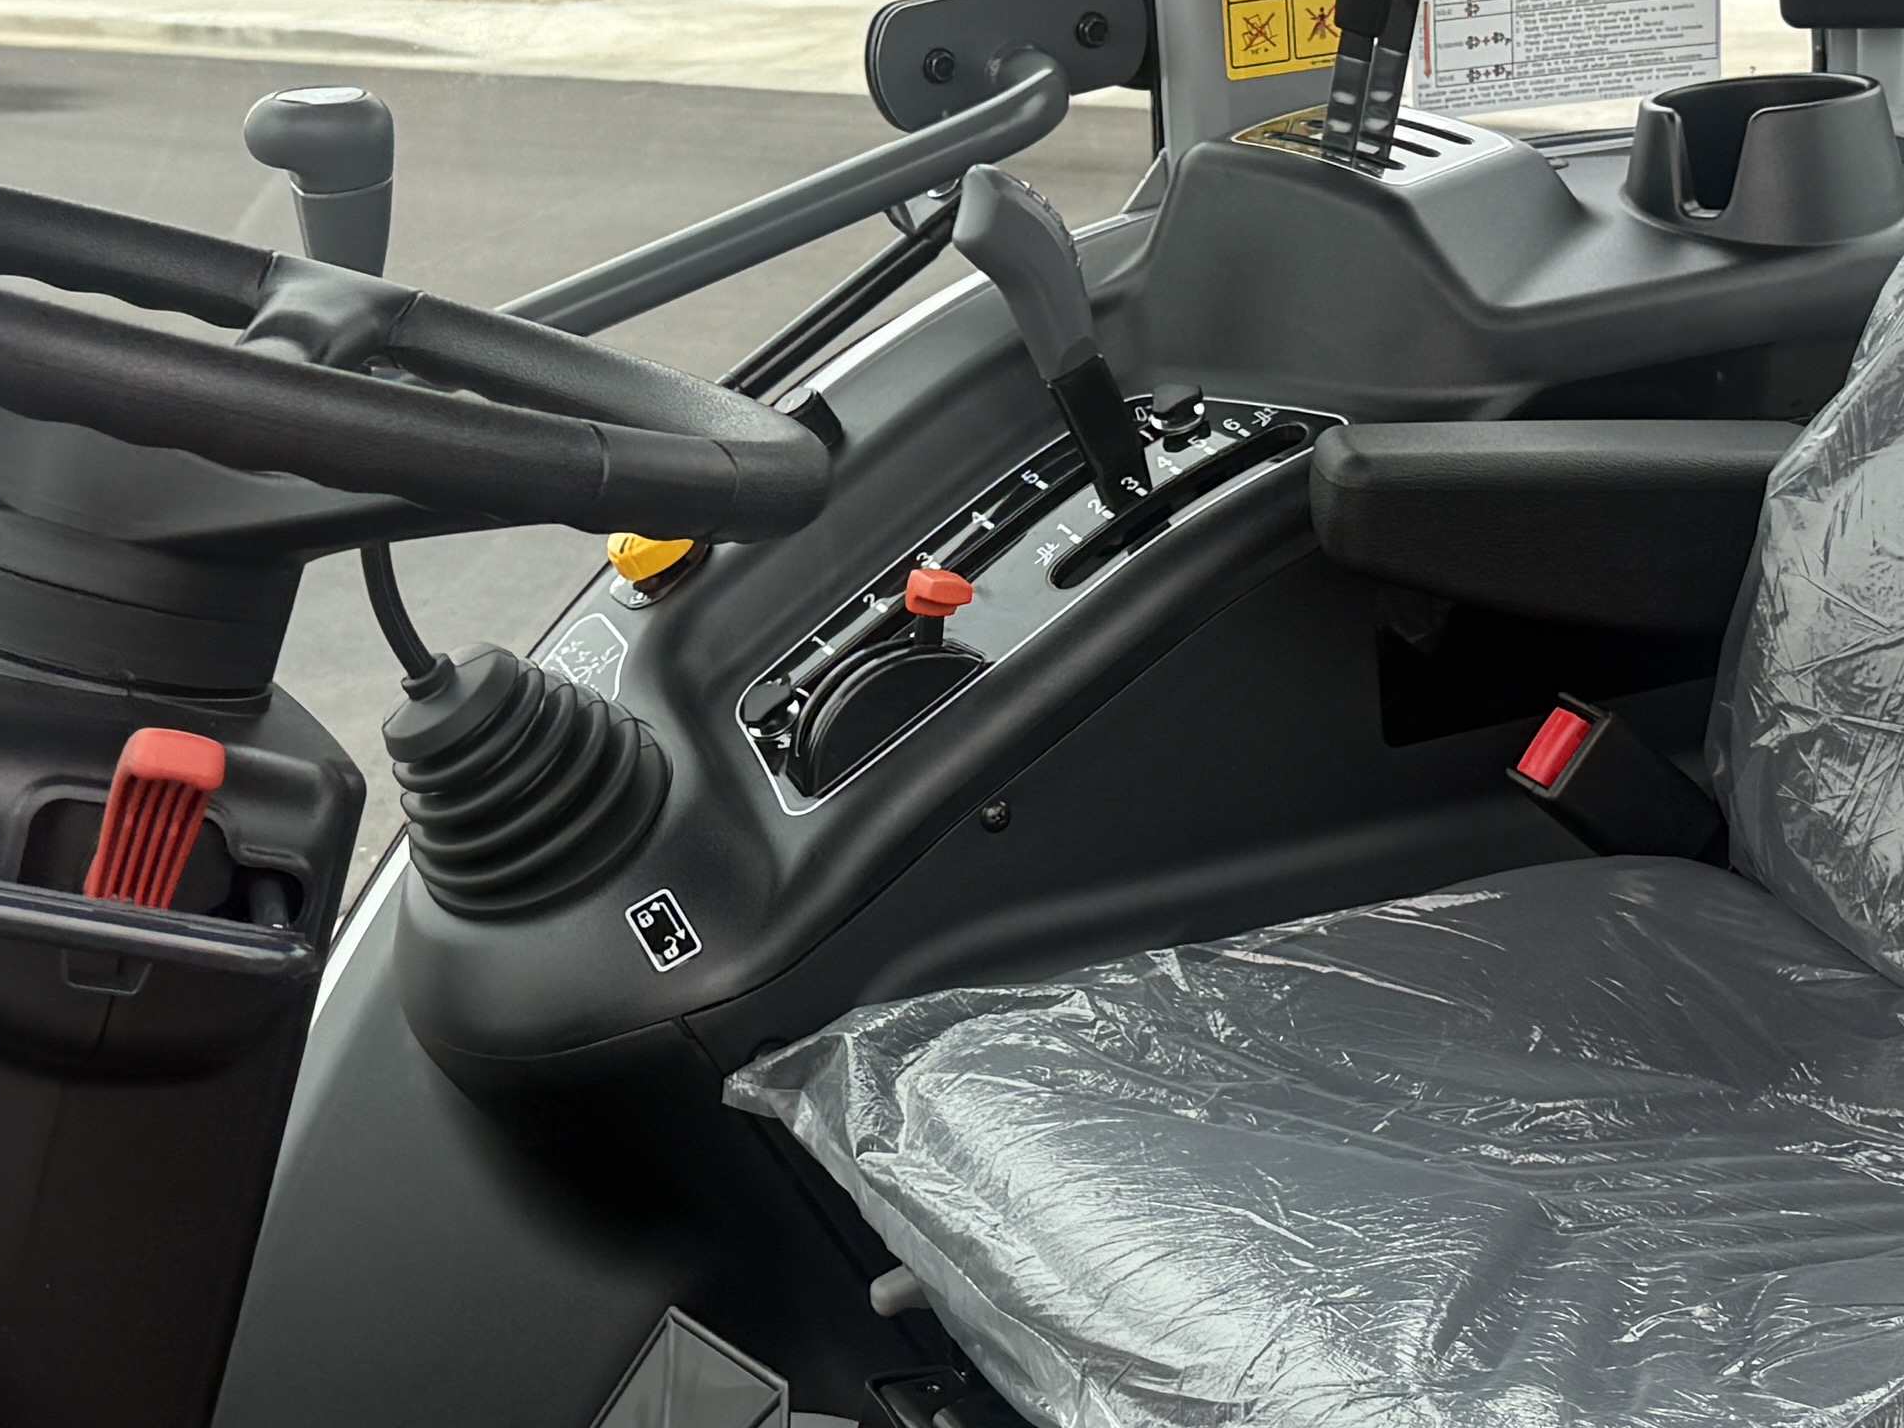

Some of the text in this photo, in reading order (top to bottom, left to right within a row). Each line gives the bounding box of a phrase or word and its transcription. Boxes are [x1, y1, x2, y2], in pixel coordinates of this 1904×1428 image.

[1222, 418, 1241, 432] 6
[1188, 435, 1206, 451] 5
[1157, 455, 1173, 470] 4
[1021, 469, 1039, 486] 5
[1120, 476, 1139, 492] 3
[1087, 498, 1105, 515] 2
[971, 511, 987, 526] 4
[1056, 522, 1072, 536] 1
[916, 552, 933, 566] 3
[863, 593, 878, 608] 2
[812, 635, 824, 648] 1
